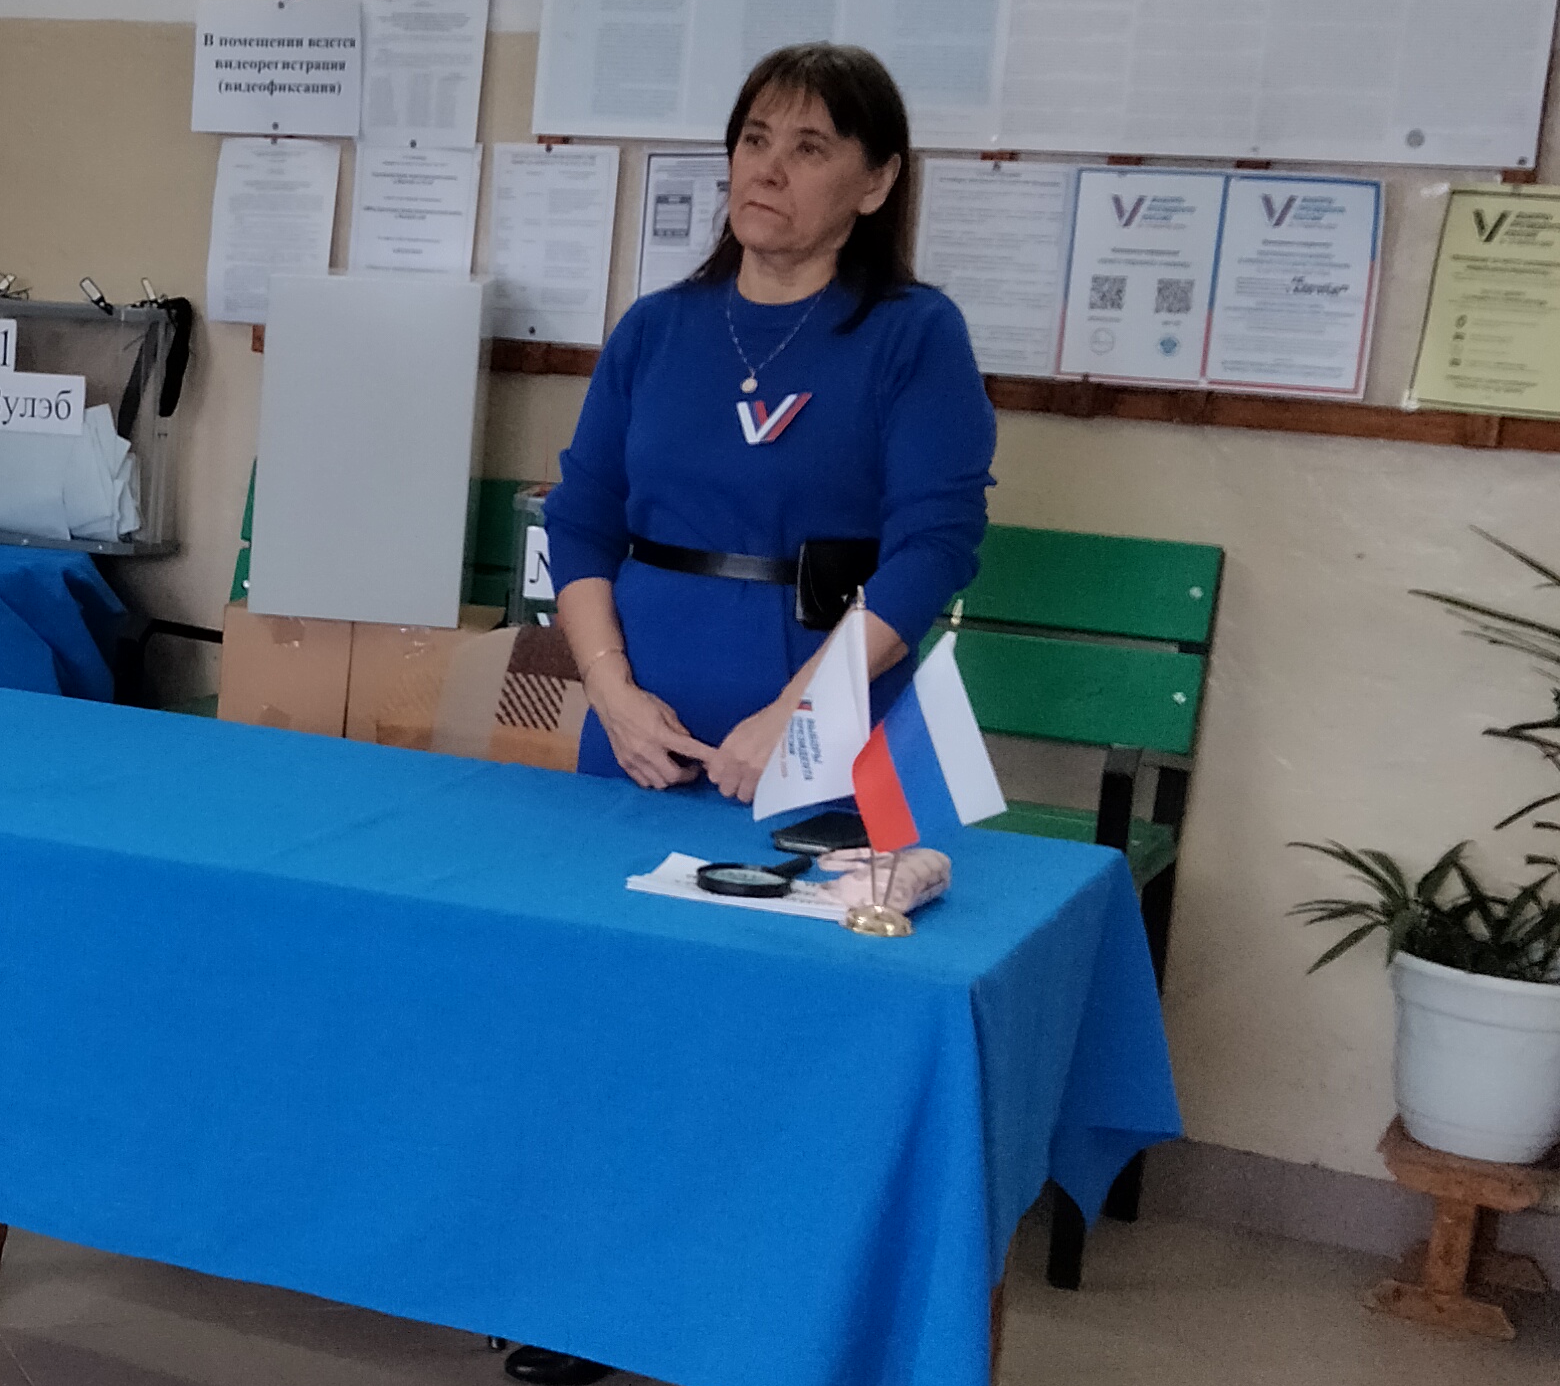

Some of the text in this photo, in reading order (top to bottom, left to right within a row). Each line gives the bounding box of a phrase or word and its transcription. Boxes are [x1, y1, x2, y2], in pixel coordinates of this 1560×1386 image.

[203, 32, 357, 50] В помещении ведется
[215, 58, 347, 75] видеорегистрация
[218, 78, 342, 97] (видеофиксация)
[0, 328, 10, 367] 1
